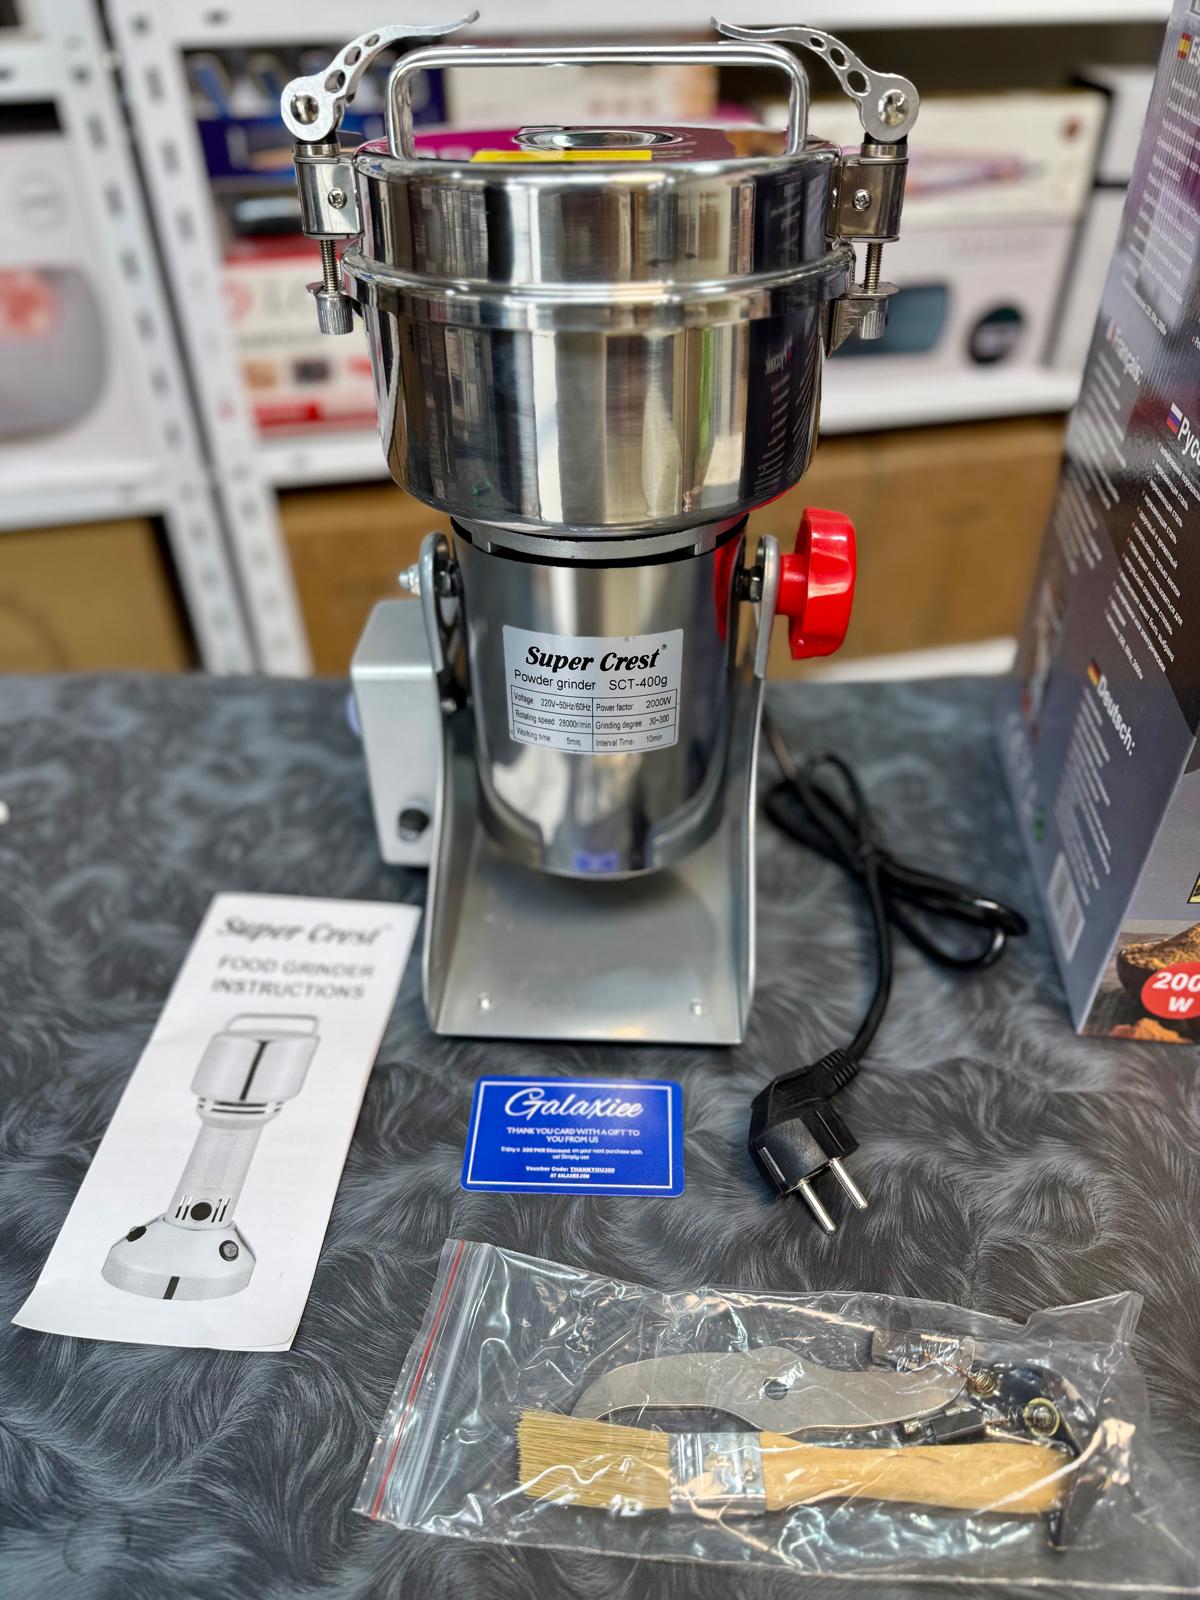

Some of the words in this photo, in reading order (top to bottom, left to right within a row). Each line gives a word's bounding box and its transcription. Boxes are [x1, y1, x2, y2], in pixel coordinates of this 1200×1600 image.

[526, 646, 594, 673] Super
[514, 669, 553, 687] Powder
[557, 678, 596, 691] grinder
[609, 675, 668, 691] SCT-400g
[514, 693, 534, 705] Voltage
[596, 701, 615, 711] Power
[616, 702, 633, 711] factor
[646, 696, 672, 709] 2000W
[515, 709, 537, 724] Rotating
[538, 714, 555, 726] speed
[1097, 675, 1136, 757] Deutsch:
[516, 726, 537, 741] Working
[595, 721, 620, 731] Grinding
[622, 719, 642, 730] degree
[595, 738, 617, 747] Interval
[217, 916, 303, 943] Super
[217, 955, 278, 974] FOOD
[282, 960, 375, 978] GRINDER
[211, 977, 365, 1000] INSTRUCTIONS
[1168, 995, 1194, 1013] W
[504, 1087, 644, 1121] Galaxiee
[506, 1127, 535, 1135] THANK
[554, 1128, 576, 1136] CARD
[576, 1128, 600, 1136] WITH
[627, 1129, 640, 1137] TO
[546, 1135, 564, 1143] YOU
